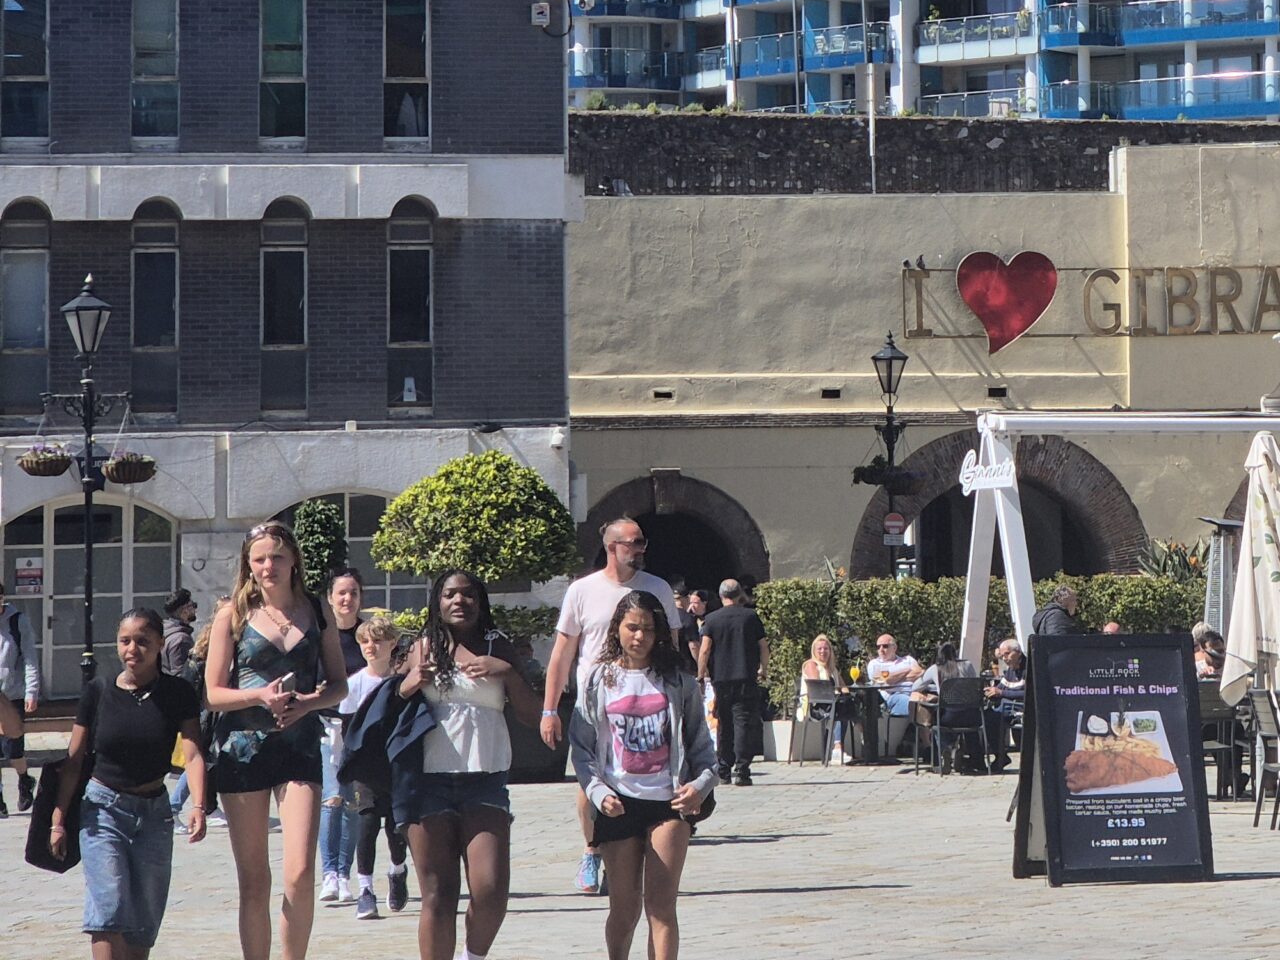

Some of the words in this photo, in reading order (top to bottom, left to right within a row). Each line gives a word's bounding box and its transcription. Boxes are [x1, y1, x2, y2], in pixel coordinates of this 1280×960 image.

[906, 269, 933, 337] I
[1053, 685, 1110, 695] Traditional
[1113, 685, 1135, 695] Fish
[1137, 685, 1146, 694] &
[1149, 684, 1178, 695] Chips
[1065, 798, 1091, 806] Prepared
[1107, 818, 1146, 828] £13.95
[1091, 839, 1120, 847] (+350)
